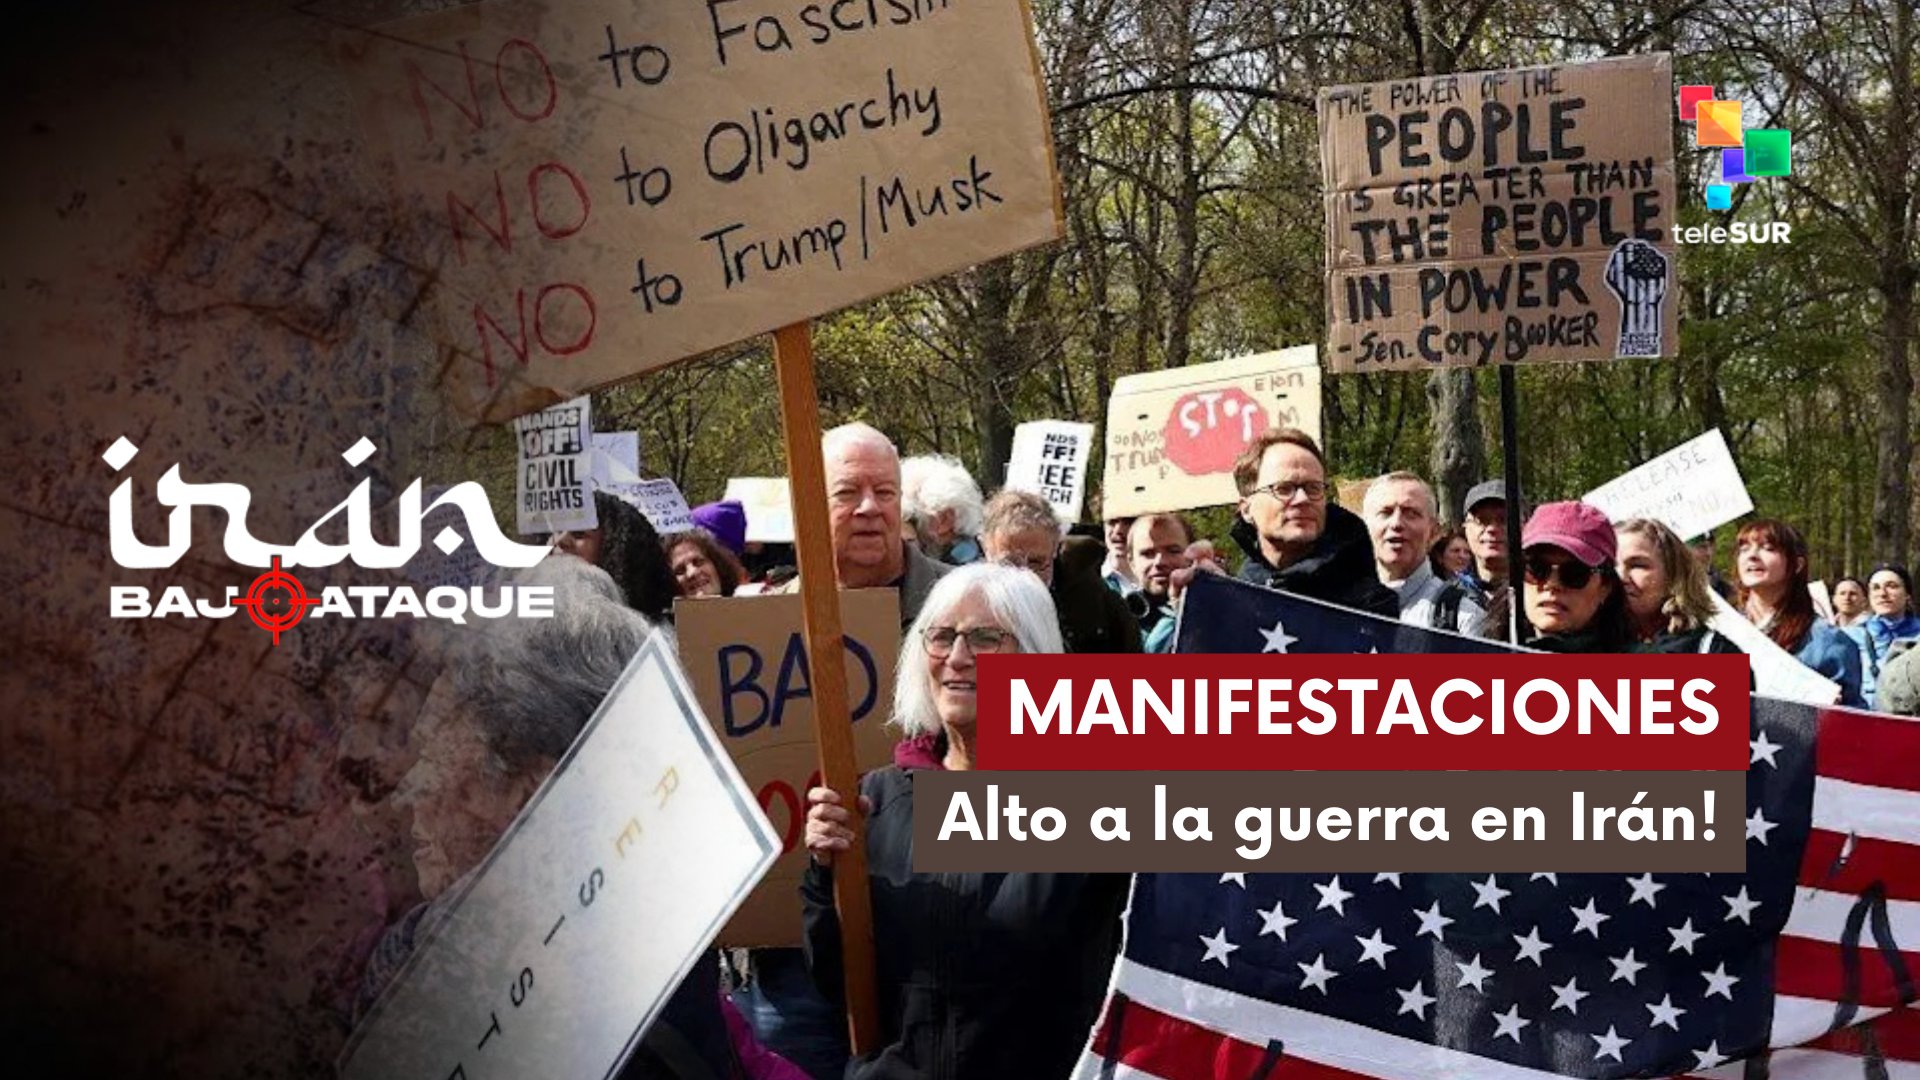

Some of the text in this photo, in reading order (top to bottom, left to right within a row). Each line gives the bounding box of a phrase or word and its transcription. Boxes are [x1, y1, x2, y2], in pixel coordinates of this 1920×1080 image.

[403, 38, 557, 142] NO
[600, 25, 669, 88] to
[1328, 67, 1564, 119] THE POWER OF THE
[1365, 98, 1586, 177] PEOPLE
[446, 68, 942, 267] NO to Oligarchy
[1345, 157, 1654, 214] IS GREATER THAN
[1351, 190, 1663, 266] THE PEOPLE
[473, 155, 1004, 389] NO to Trump/Musk
[1345, 257, 1589, 323] IN POWER
[1417, 324, 1499, 364] Cory
[521, 409, 580, 430] HANDS
[523, 427, 581, 456] OFF!
[1045, 432, 1078, 445] NDS
[1179, 392, 1258, 442] STOP
[526, 458, 583, 490] CIVIL
[1042, 444, 1076, 462] FF!
[524, 488, 584, 514] RIGHTS
